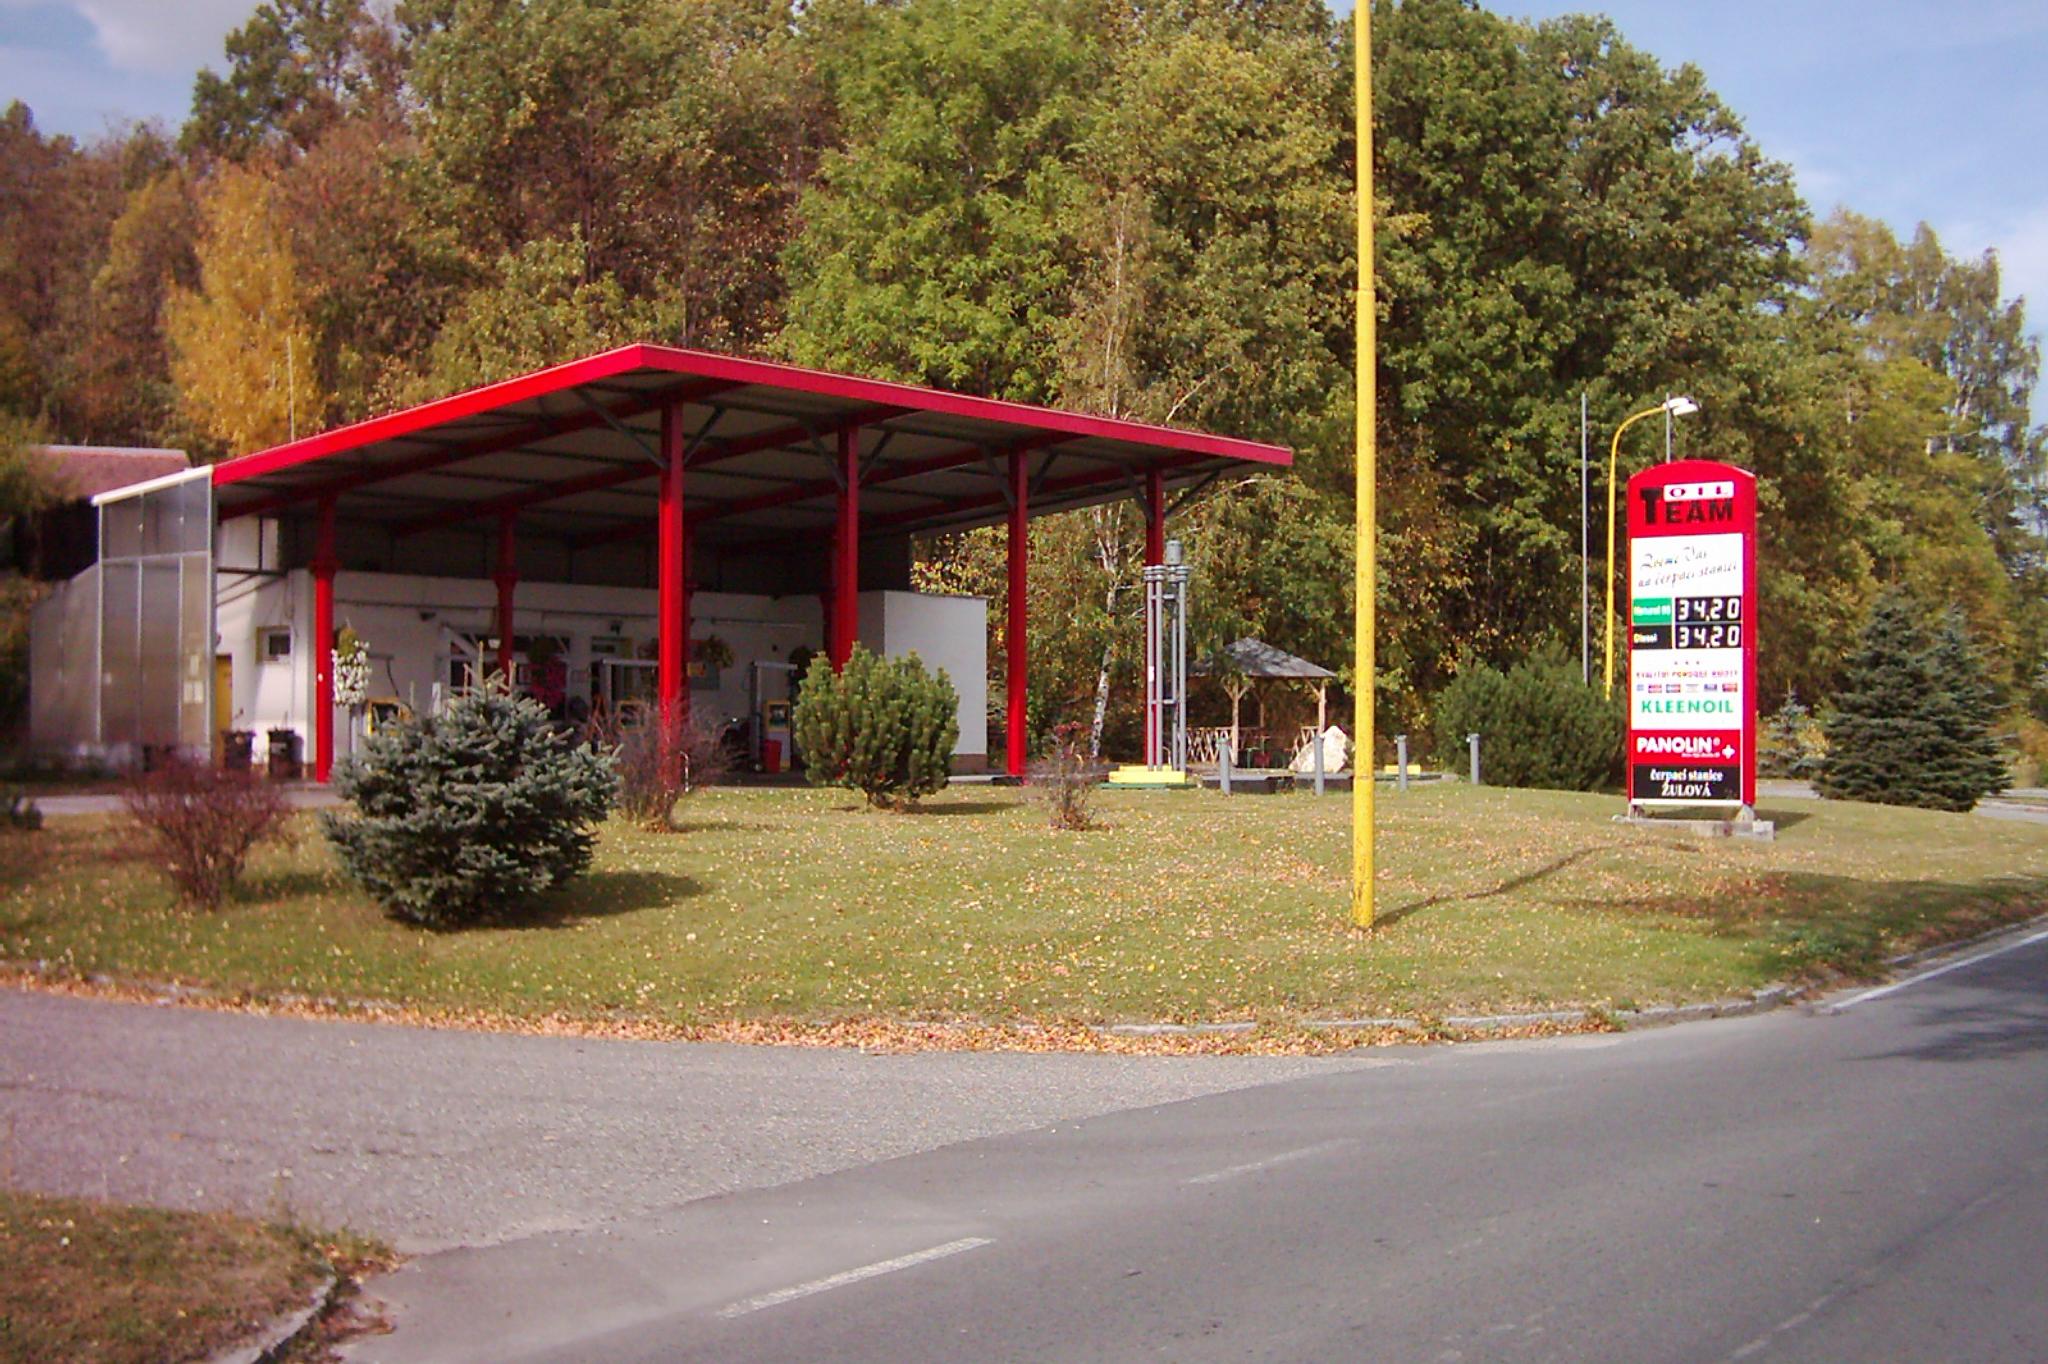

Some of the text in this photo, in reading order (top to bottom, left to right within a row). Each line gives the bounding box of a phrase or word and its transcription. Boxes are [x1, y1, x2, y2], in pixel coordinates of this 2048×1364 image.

[1669, 486, 1729, 498] OIL
[1640, 488, 1733, 524] TEAM
[1678, 598, 1740, 622] 34,20
[1678, 625, 1740, 649] 34,20
[1640, 699, 1734, 714] KLEENOIL
[1636, 737, 1713, 753] PANOLIN
[1688, 768, 1724, 782] stanice
[1661, 780, 1712, 797] ŽULOVÁ
